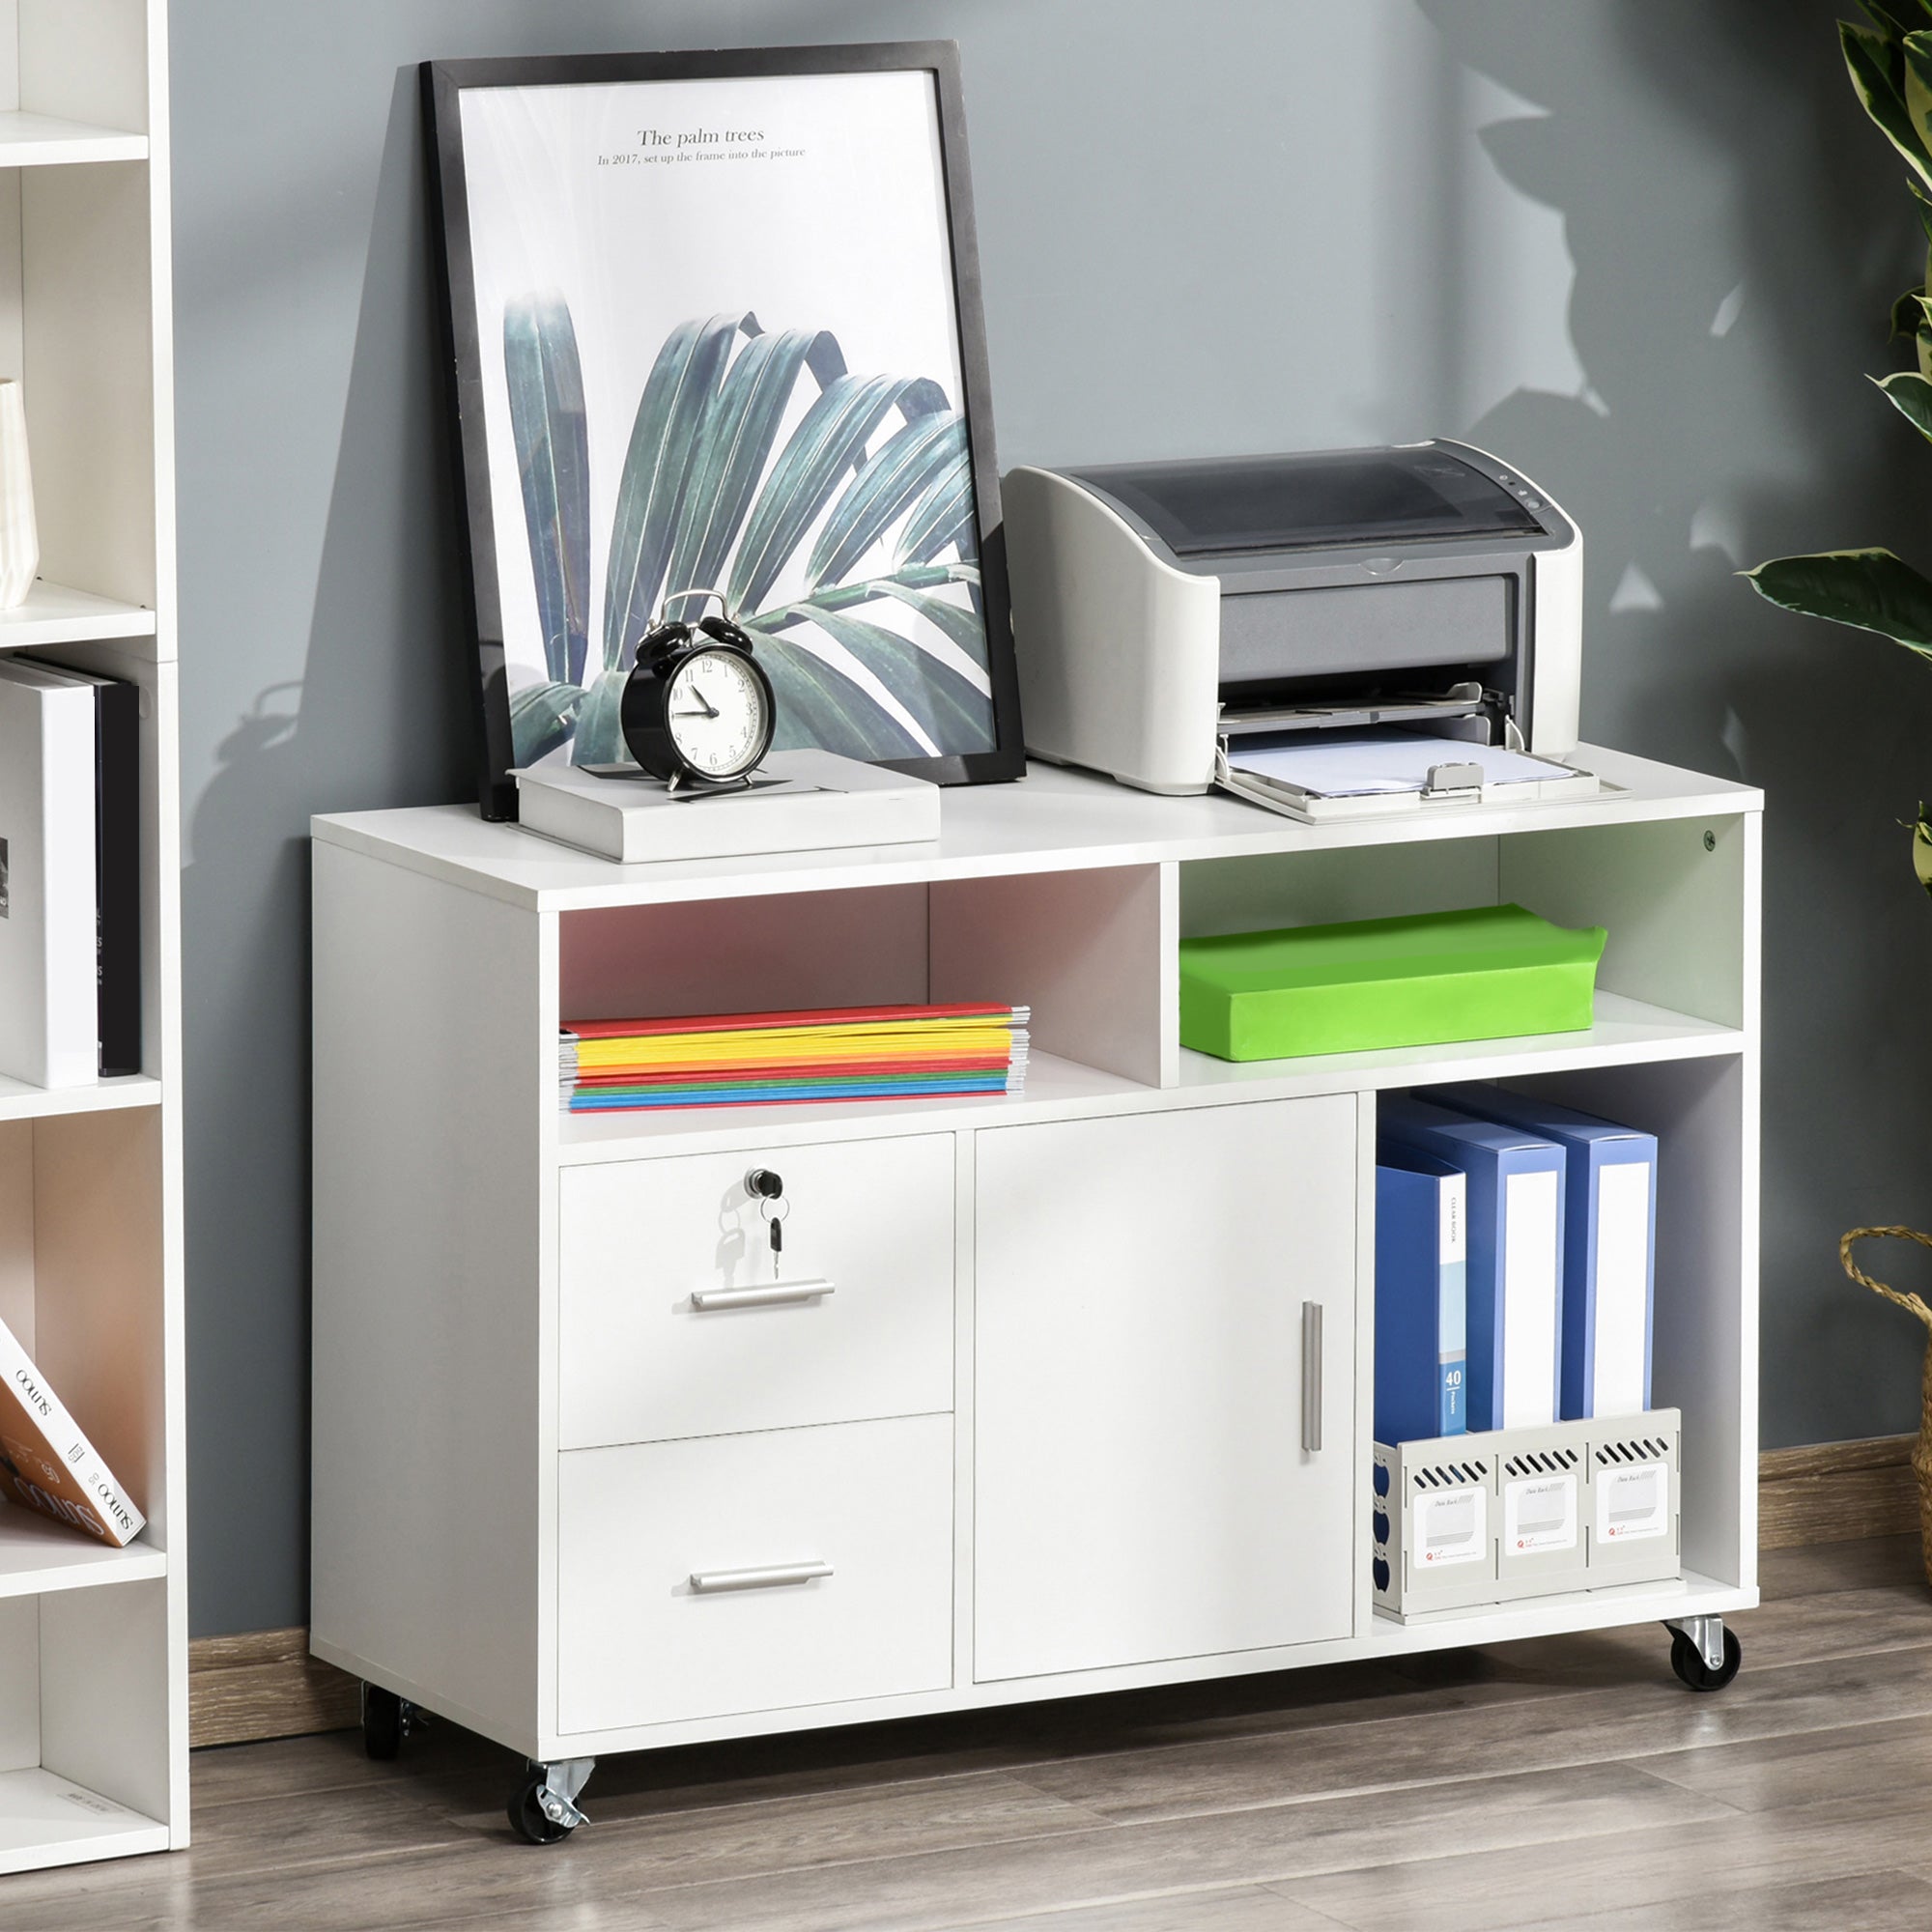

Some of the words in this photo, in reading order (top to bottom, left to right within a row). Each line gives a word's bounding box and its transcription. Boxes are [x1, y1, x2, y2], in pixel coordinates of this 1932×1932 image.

[638, 129, 672, 146] The
[676, 128, 719, 148] palm
[724, 128, 765, 142] trees
[598, 155, 610, 165] In
[611, 154, 641, 165] 2017,
[643, 154, 658, 163] set
[660, 155, 674, 164] up
[676, 152, 694, 162] the
[695, 151, 724, 161] frame
[727, 149, 749, 159] into
[751, 148, 767, 158] the
[770, 146, 806, 159] picture
[701, 660, 713, 673] 12
[724, 664, 728, 677] 1
[685, 668, 694, 682] 11
[737, 679, 745, 693] 2
[672, 687, 683, 701] 10
[746, 702, 753, 716] 3
[740, 725, 748, 739] 4
[691, 747, 697, 760] 7
[729, 745, 736, 758] 5
[709, 753, 718, 766] 6
[1445, 1370, 1462, 1386] 40
